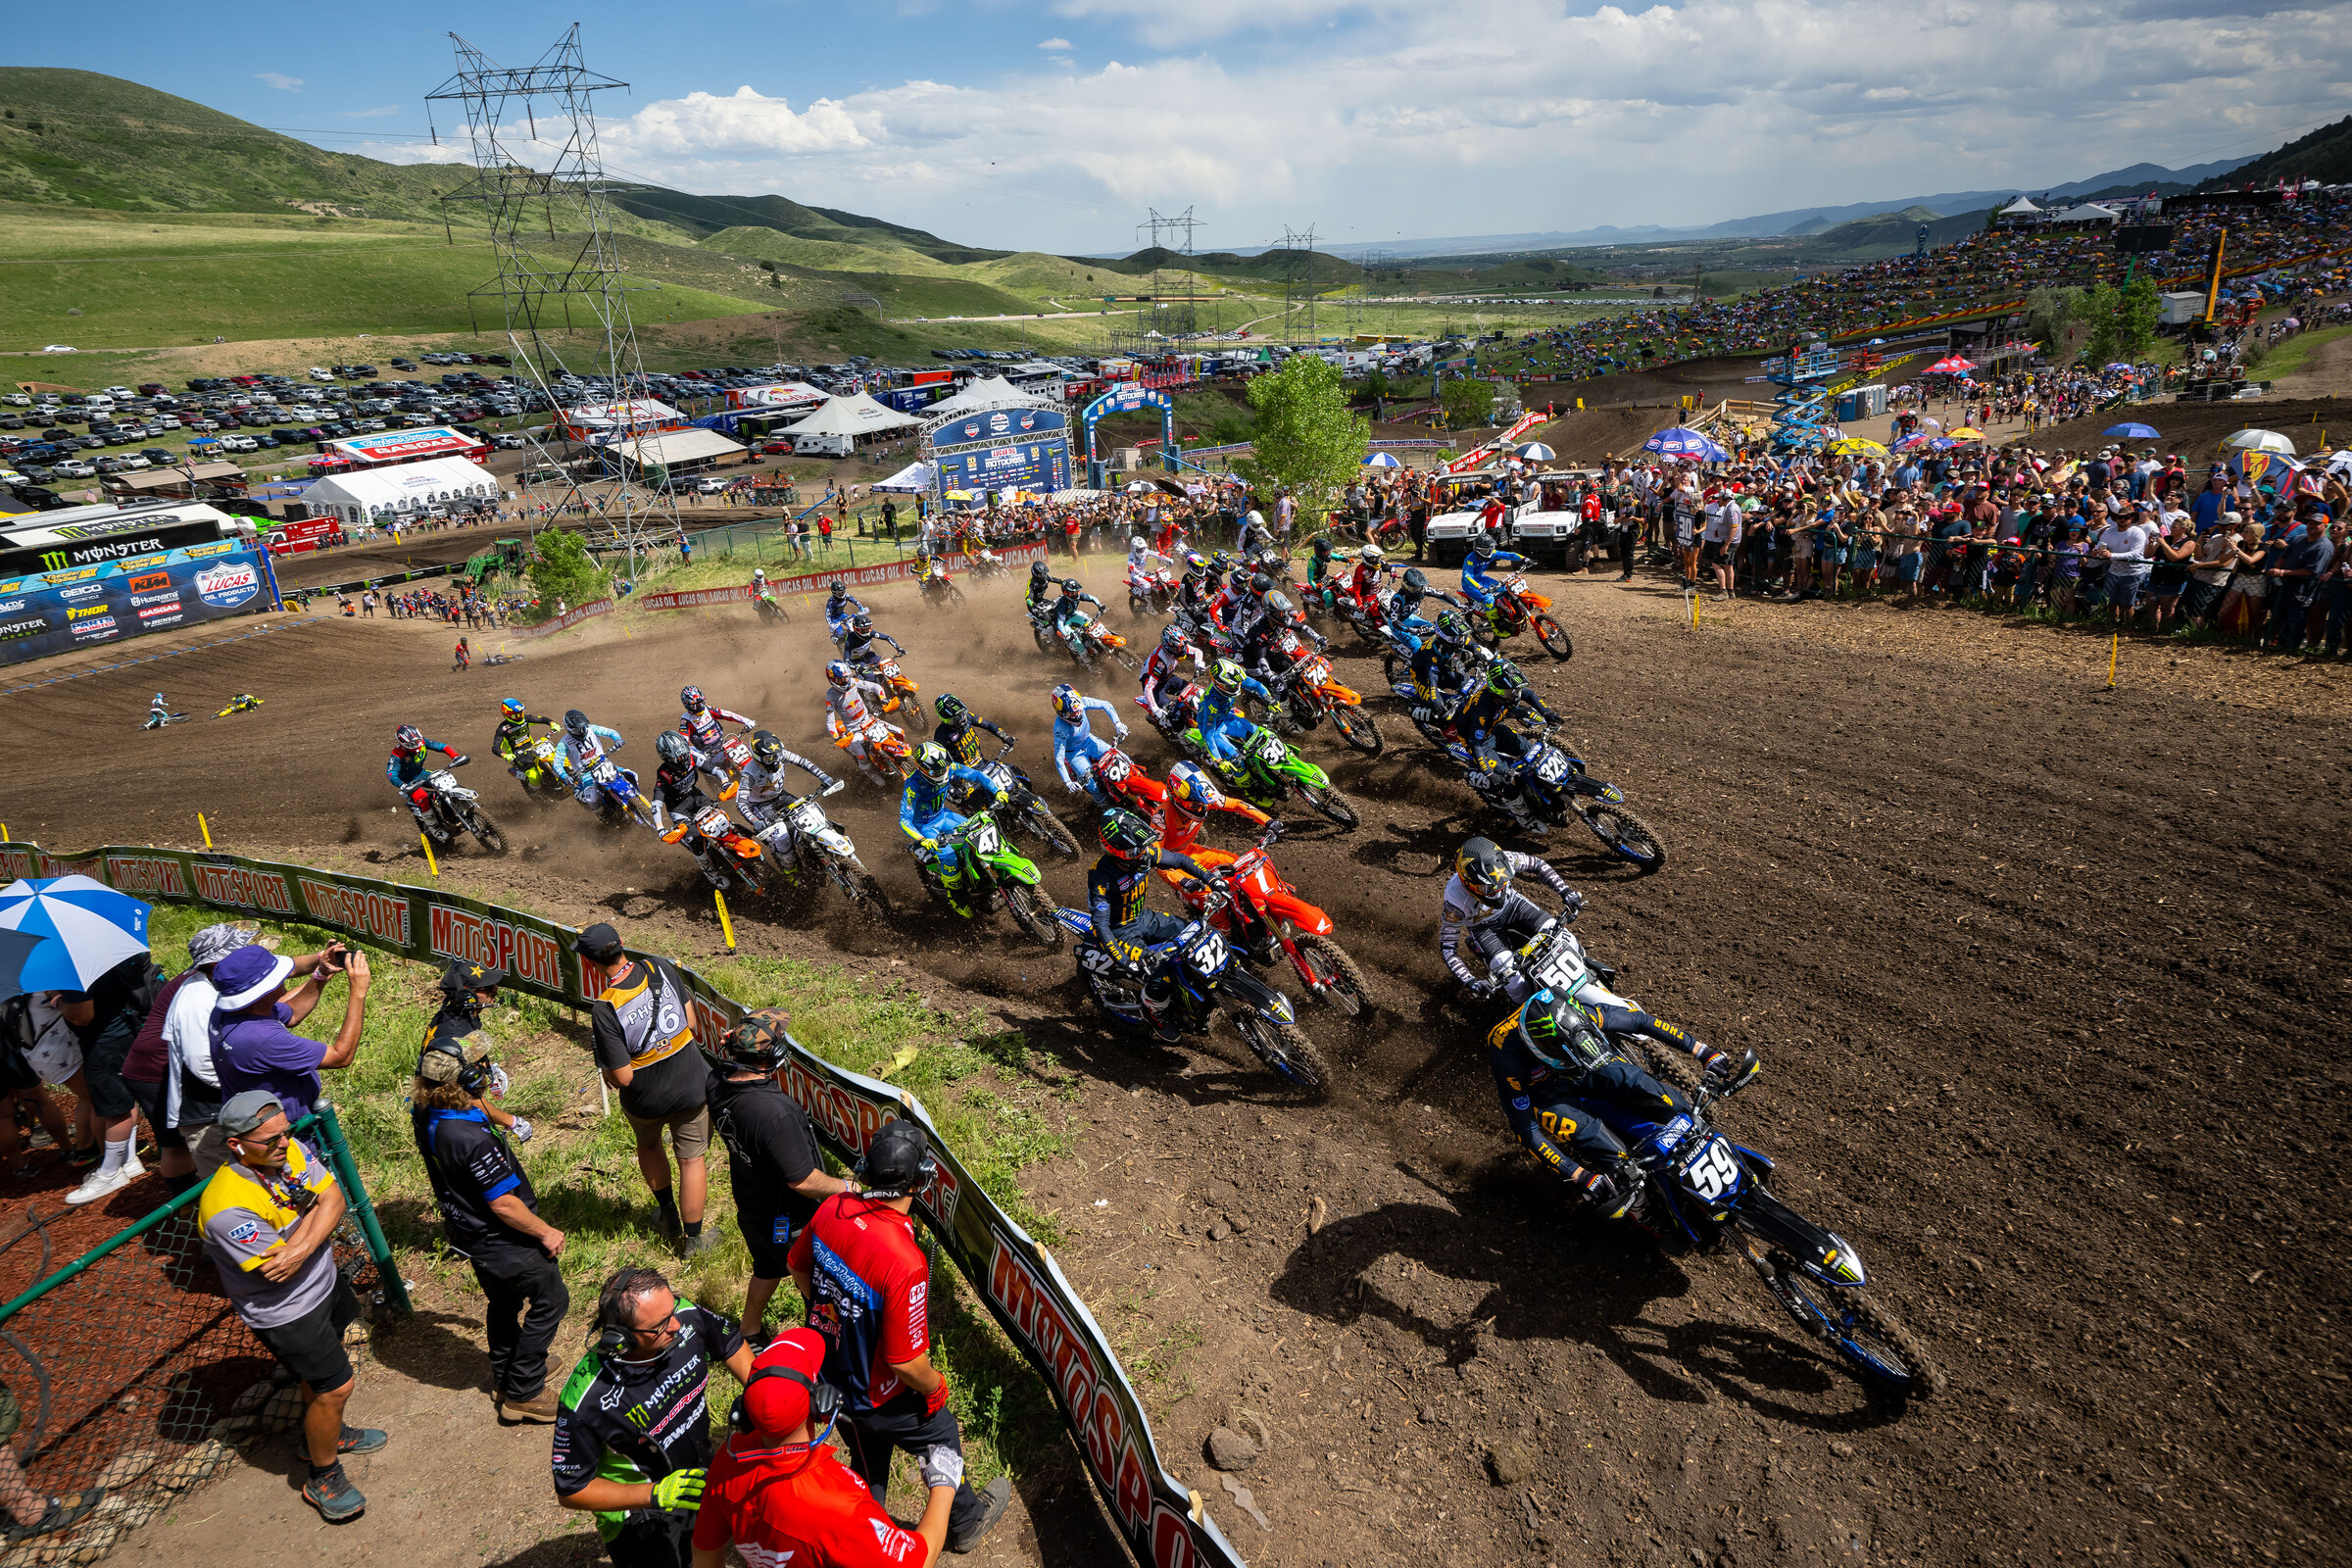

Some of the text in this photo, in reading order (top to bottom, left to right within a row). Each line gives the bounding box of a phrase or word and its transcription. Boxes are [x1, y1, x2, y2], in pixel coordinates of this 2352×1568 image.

[1123, 401, 1140, 410] FINISH
[1828, 428, 1837, 438] 8
[374, 437, 458, 455] GASGAS
[985, 456, 1026, 468] MOTOCROSS
[1679, 515, 1692, 539] 30
[73, 539, 165, 563] MONSTER
[216, 543, 234, 553] MX
[149, 555, 168, 565] MX
[78, 568, 98, 579] MX
[206, 573, 251, 592] LUCAS
[644, 596, 663, 609] LUCAS
[664, 595, 676, 607] OIL
[678, 593, 696, 606] LUCAS
[697, 592, 707, 604] OIL
[710, 590, 729, 602] LUCAS
[730, 589, 740, 600] OIL
[779, 581, 801, 594] LUCAS
[802, 579, 814, 590] OIL
[844, 571, 857, 585] OIL
[860, 569, 886, 583] LUCAS
[887, 565, 901, 579] OIL
[1000, 548, 1029, 565] LUCAS
[1031, 545, 1047, 562] OIL
[60, 584, 102, 598] GEICO
[133, 576, 168, 592] KTM
[219, 586, 256, 599] PRODUCTS
[140, 591, 179, 604] Husqvarna
[76, 605, 109, 617] THOR
[139, 604, 180, 617] GASGAS
[585, 602, 606, 615] LUCAS
[71, 615, 115, 629] PARTS
[73, 621, 116, 634] UNLIMITED
[151, 614, 183, 625] DUNLOP
[883, 664, 901, 677] 604
[1306, 665, 1328, 685] 74
[868, 724, 888, 742] 36
[956, 727, 976, 750] THOR
[576, 737, 595, 754] FLY
[728, 745, 748, 763] 29
[1263, 739, 1286, 764] 30
[1109, 760, 1131, 781] 96
[1469, 771, 1491, 789] 329
[704, 813, 730, 838] 38
[978, 825, 1000, 854] 47
[1255, 866, 1271, 893] 1
[109, 856, 185, 895] MOTOSPORT
[194, 863, 291, 912] MOTOSPORT
[300, 878, 409, 947] MOTOSPORT
[431, 906, 562, 990] MOTOSPORT
[1058, 919, 1081, 935] DUNLOP
[1105, 940, 1123, 960] THOR
[1196, 932, 1227, 974] 32
[1082, 949, 1114, 976] 32
[1286, 953, 1309, 979] DUNLOP
[1541, 951, 1586, 991] 50
[627, 986, 672, 1025] PHOO
[1238, 1022, 1261, 1052] DUNLOP
[1654, 1018, 1684, 1040] THOR
[1590, 1051, 1614, 1069] MONSTER
[1534, 1107, 1578, 1141] OR
[1685, 1138, 1708, 1163] LUCAS OIL
[1690, 1137, 1739, 1200] 59
[909, 1283, 926, 1302] PPG
[1767, 1276, 1809, 1320] DUNLOP
[809, 1313, 831, 1334] Red
[572, 1356, 594, 1389] FOX
[644, 1354, 701, 1409] MONSTER
[658, 1372, 697, 1410] ENERGY
[659, 1396, 706, 1450] awasa
